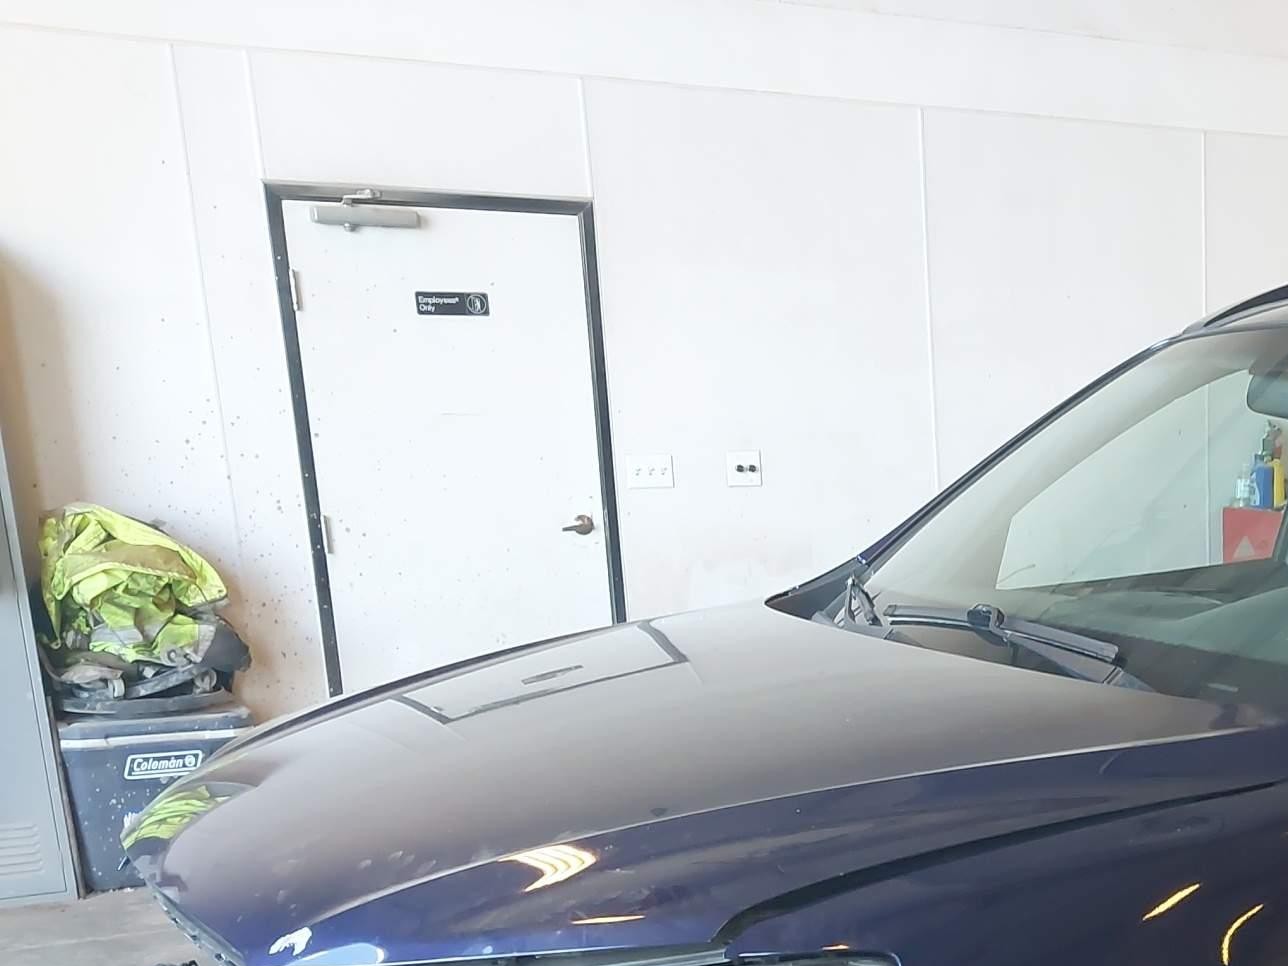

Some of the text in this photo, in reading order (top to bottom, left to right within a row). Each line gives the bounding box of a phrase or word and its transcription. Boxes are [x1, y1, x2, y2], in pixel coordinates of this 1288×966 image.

[418, 295, 460, 304] Employees
[419, 303, 435, 313] Only
[133, 756, 183, 772] Coleman
